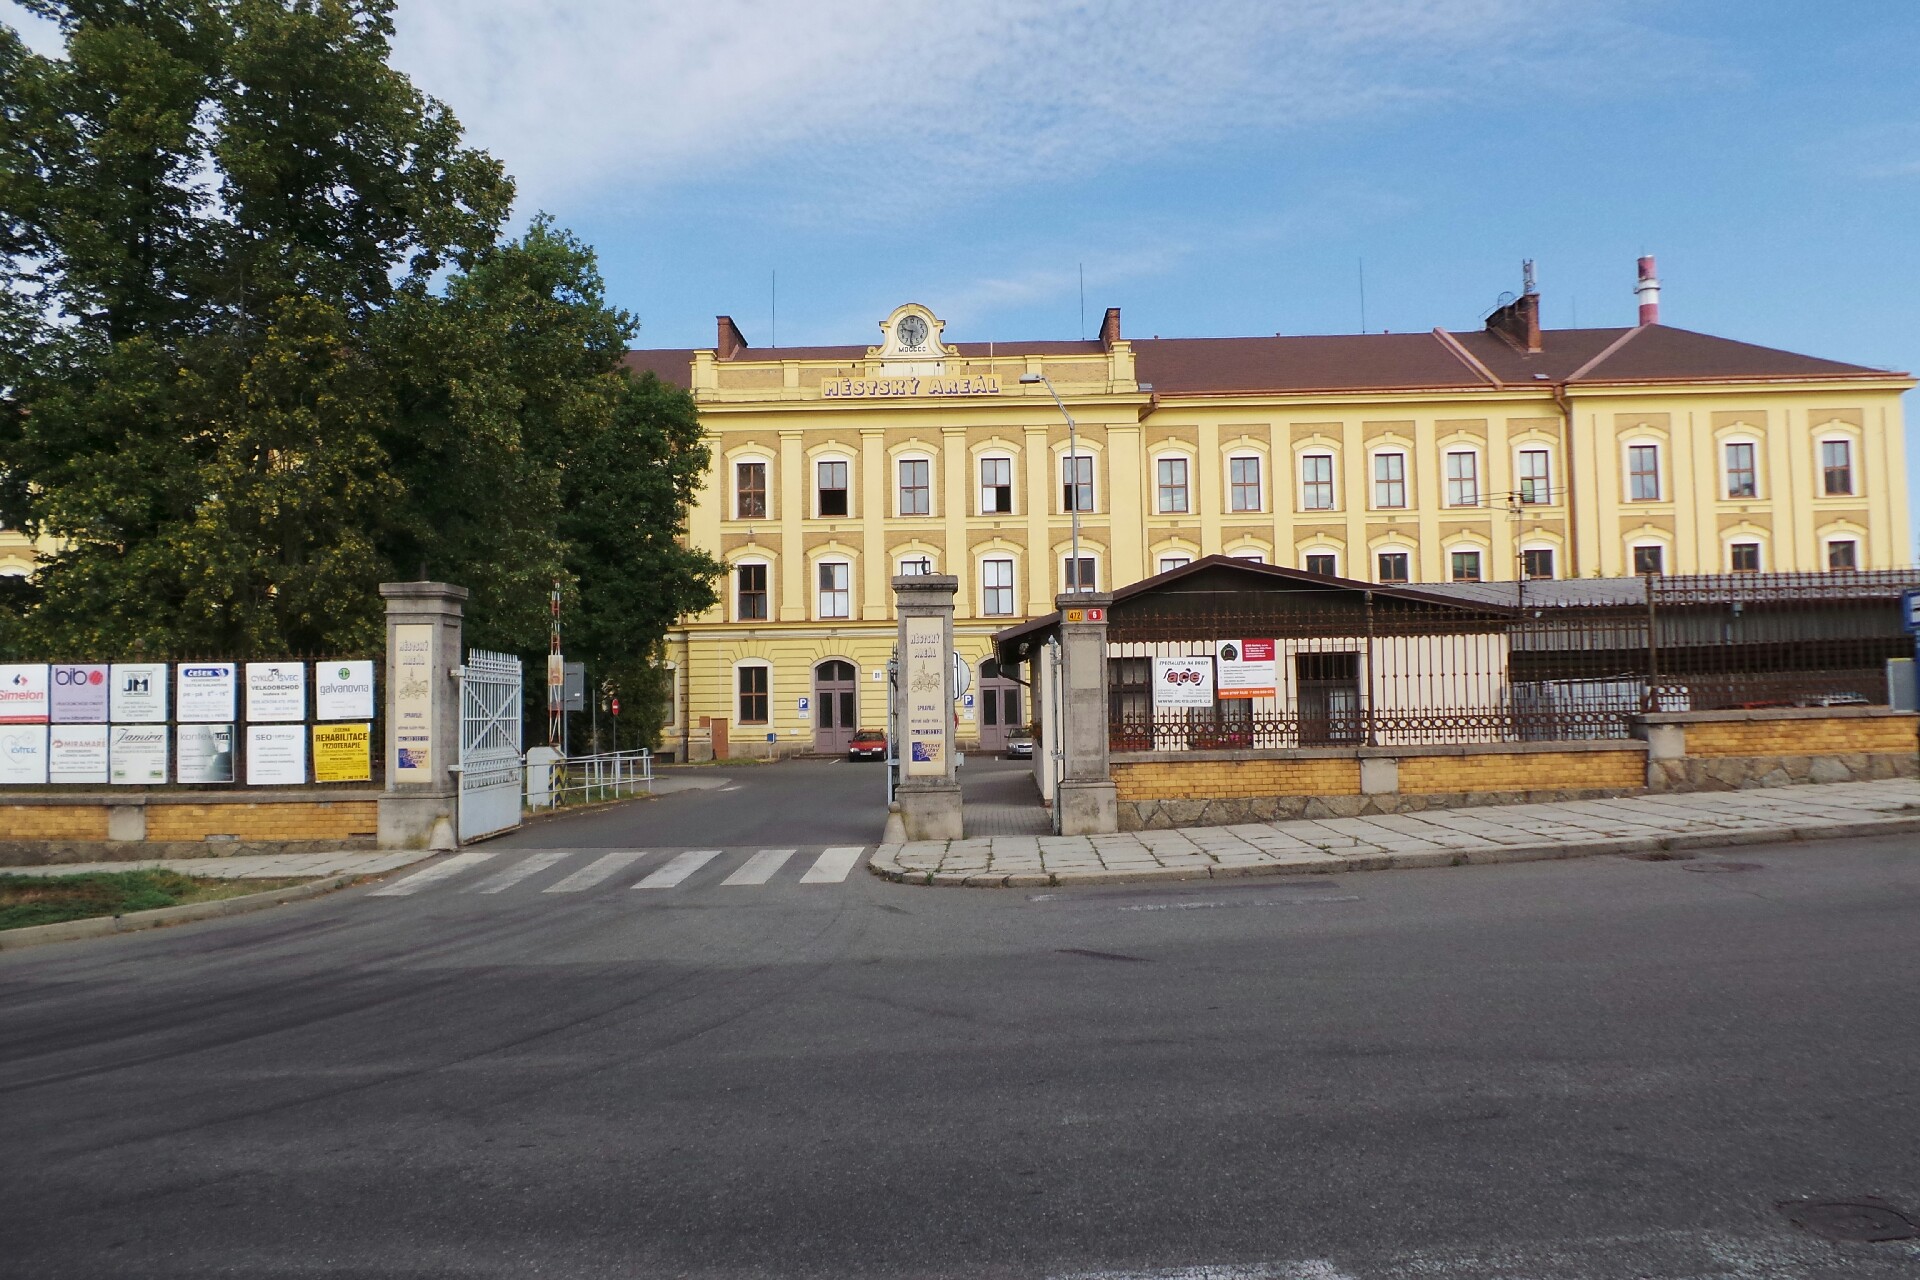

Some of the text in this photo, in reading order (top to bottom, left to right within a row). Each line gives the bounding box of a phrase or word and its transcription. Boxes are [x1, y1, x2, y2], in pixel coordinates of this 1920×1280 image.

[823, 375, 999, 396] MĚSTSKÝ AREÁL
[1092, 611, 1097, 619] 6
[279, 673, 299, 682] ŠVEC
[1167, 671, 1201, 683] ace
[320, 683, 369, 696] galvanovna
[800, 699, 806, 707] P
[965, 696, 971, 704] P
[315, 732, 368, 742] REHABILITACE
[63, 740, 106, 748] MIRAMARE
